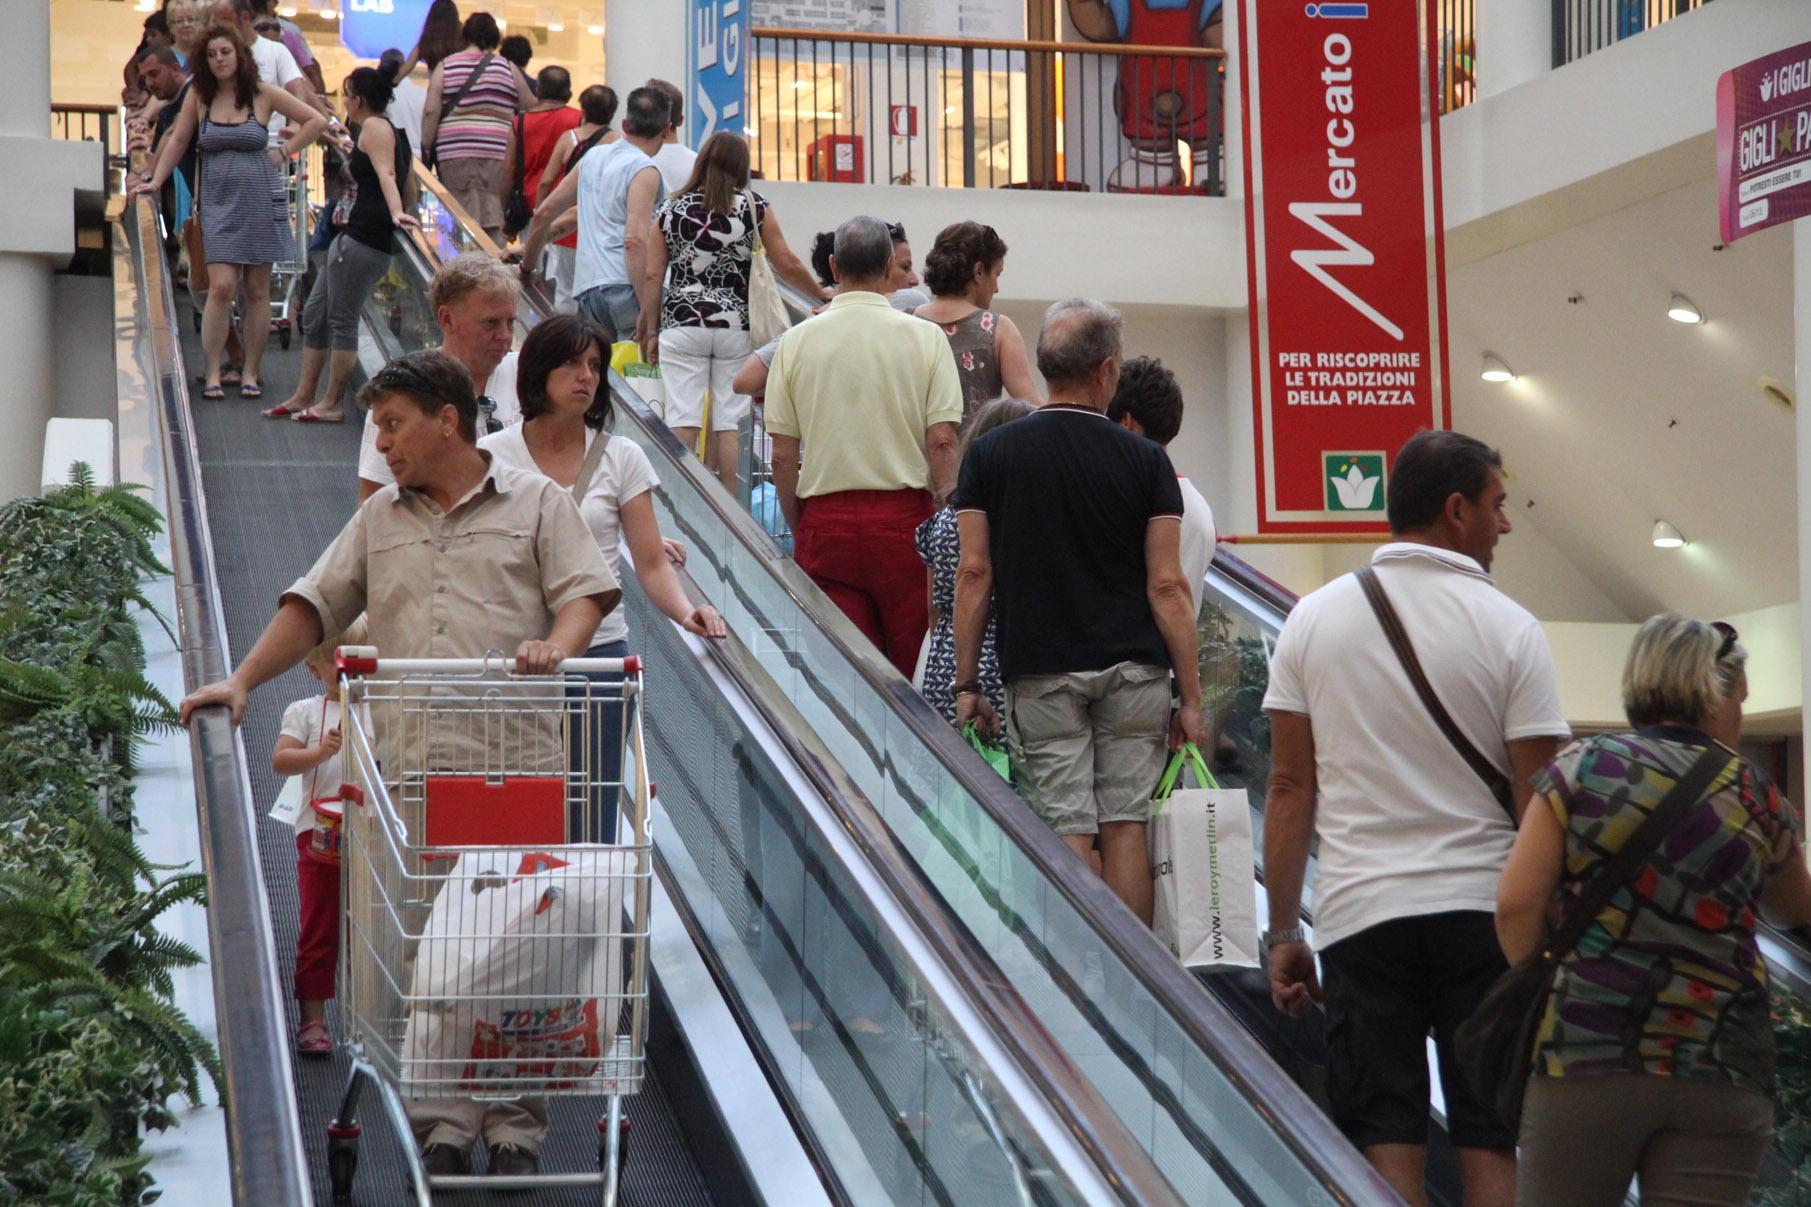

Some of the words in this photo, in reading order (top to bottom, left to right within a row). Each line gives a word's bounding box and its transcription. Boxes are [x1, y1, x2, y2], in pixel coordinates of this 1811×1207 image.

[1779, 59, 1811, 96] GIGLI
[1740, 120, 1776, 172] GIGLI
[1288, 33, 1404, 341] Mercato
[1772, 171, 1792, 186] ESSERE
[1279, 352, 1312, 368] PER
[1317, 352, 1421, 368] RISCOPRIRE
[1285, 371, 1304, 387] LE
[1308, 371, 1415, 387] TRADIZIONI
[1287, 390, 1341, 406] DELLA
[1347, 390, 1415, 406] PIAZZA
[1206, 802, 1223, 960] www.leroymerlin.it
